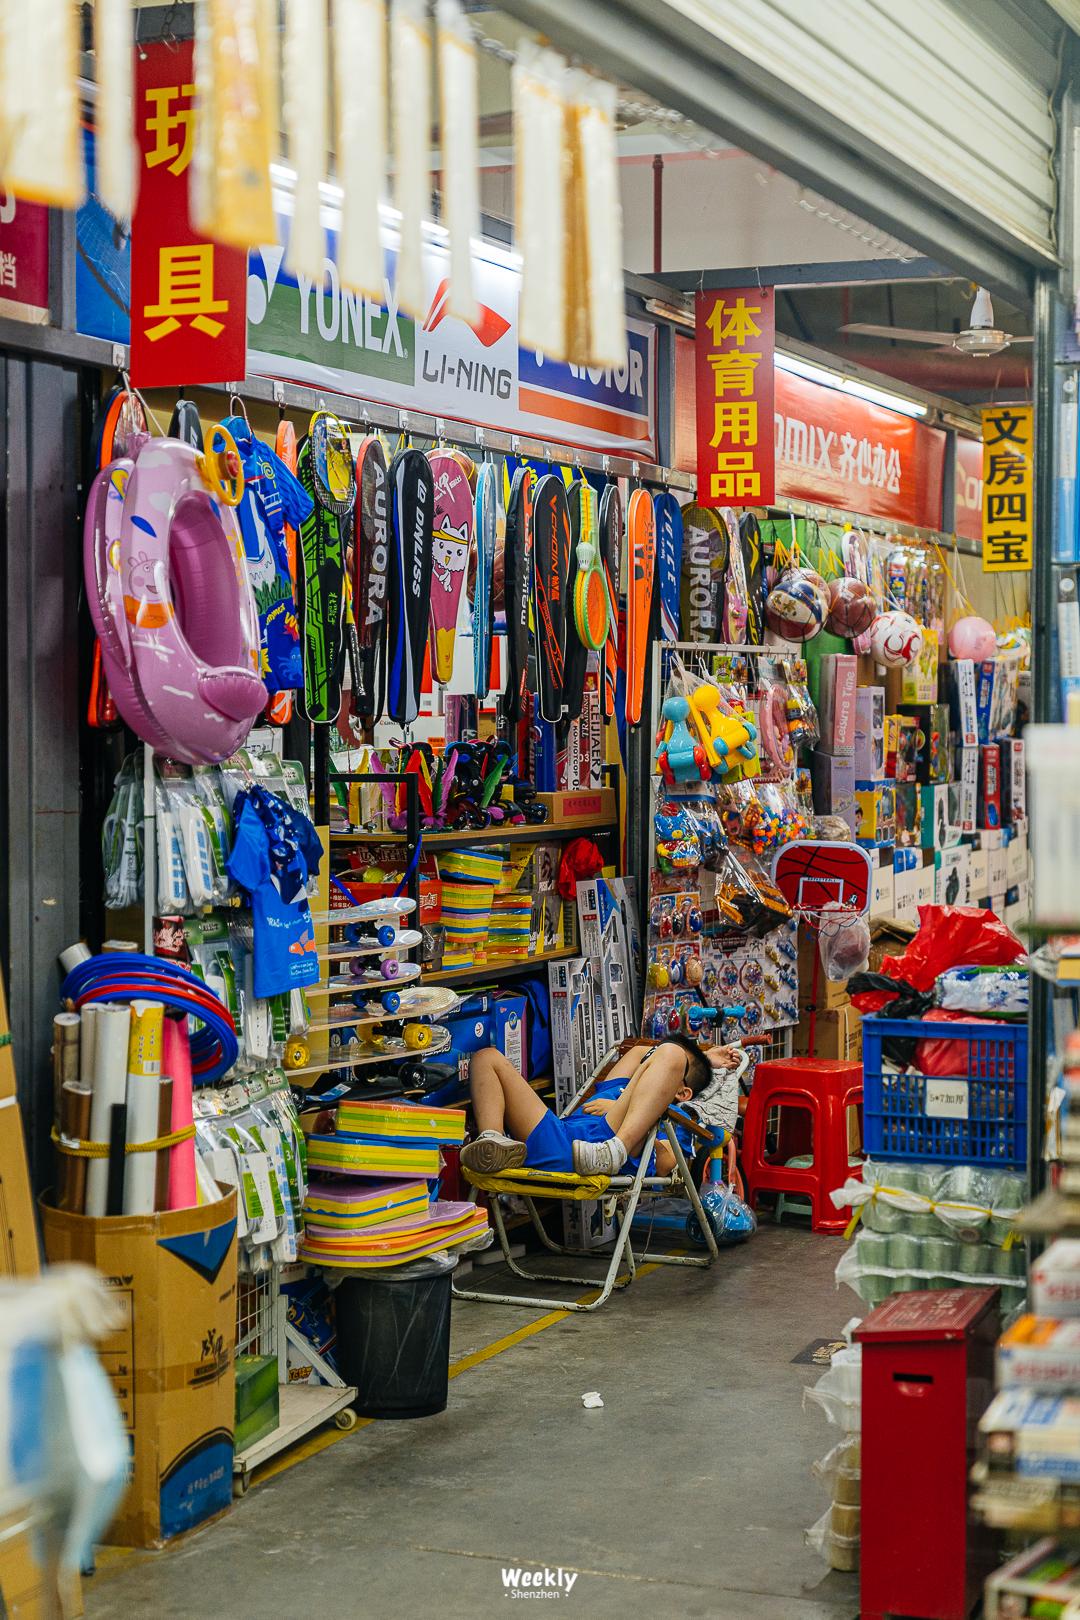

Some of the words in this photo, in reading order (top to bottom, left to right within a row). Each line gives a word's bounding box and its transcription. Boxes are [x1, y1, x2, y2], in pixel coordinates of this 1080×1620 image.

[296, 258, 406, 358] YONEX
[422, 349, 512, 400] LI-NING
[705, 297, 763, 498] 体育用品
[838, 431, 902, 495] 齐心办公
[984, 410, 1029, 565] 文房四宝
[365, 459, 390, 626] AURORA
[689, 525, 712, 643] AURORA
